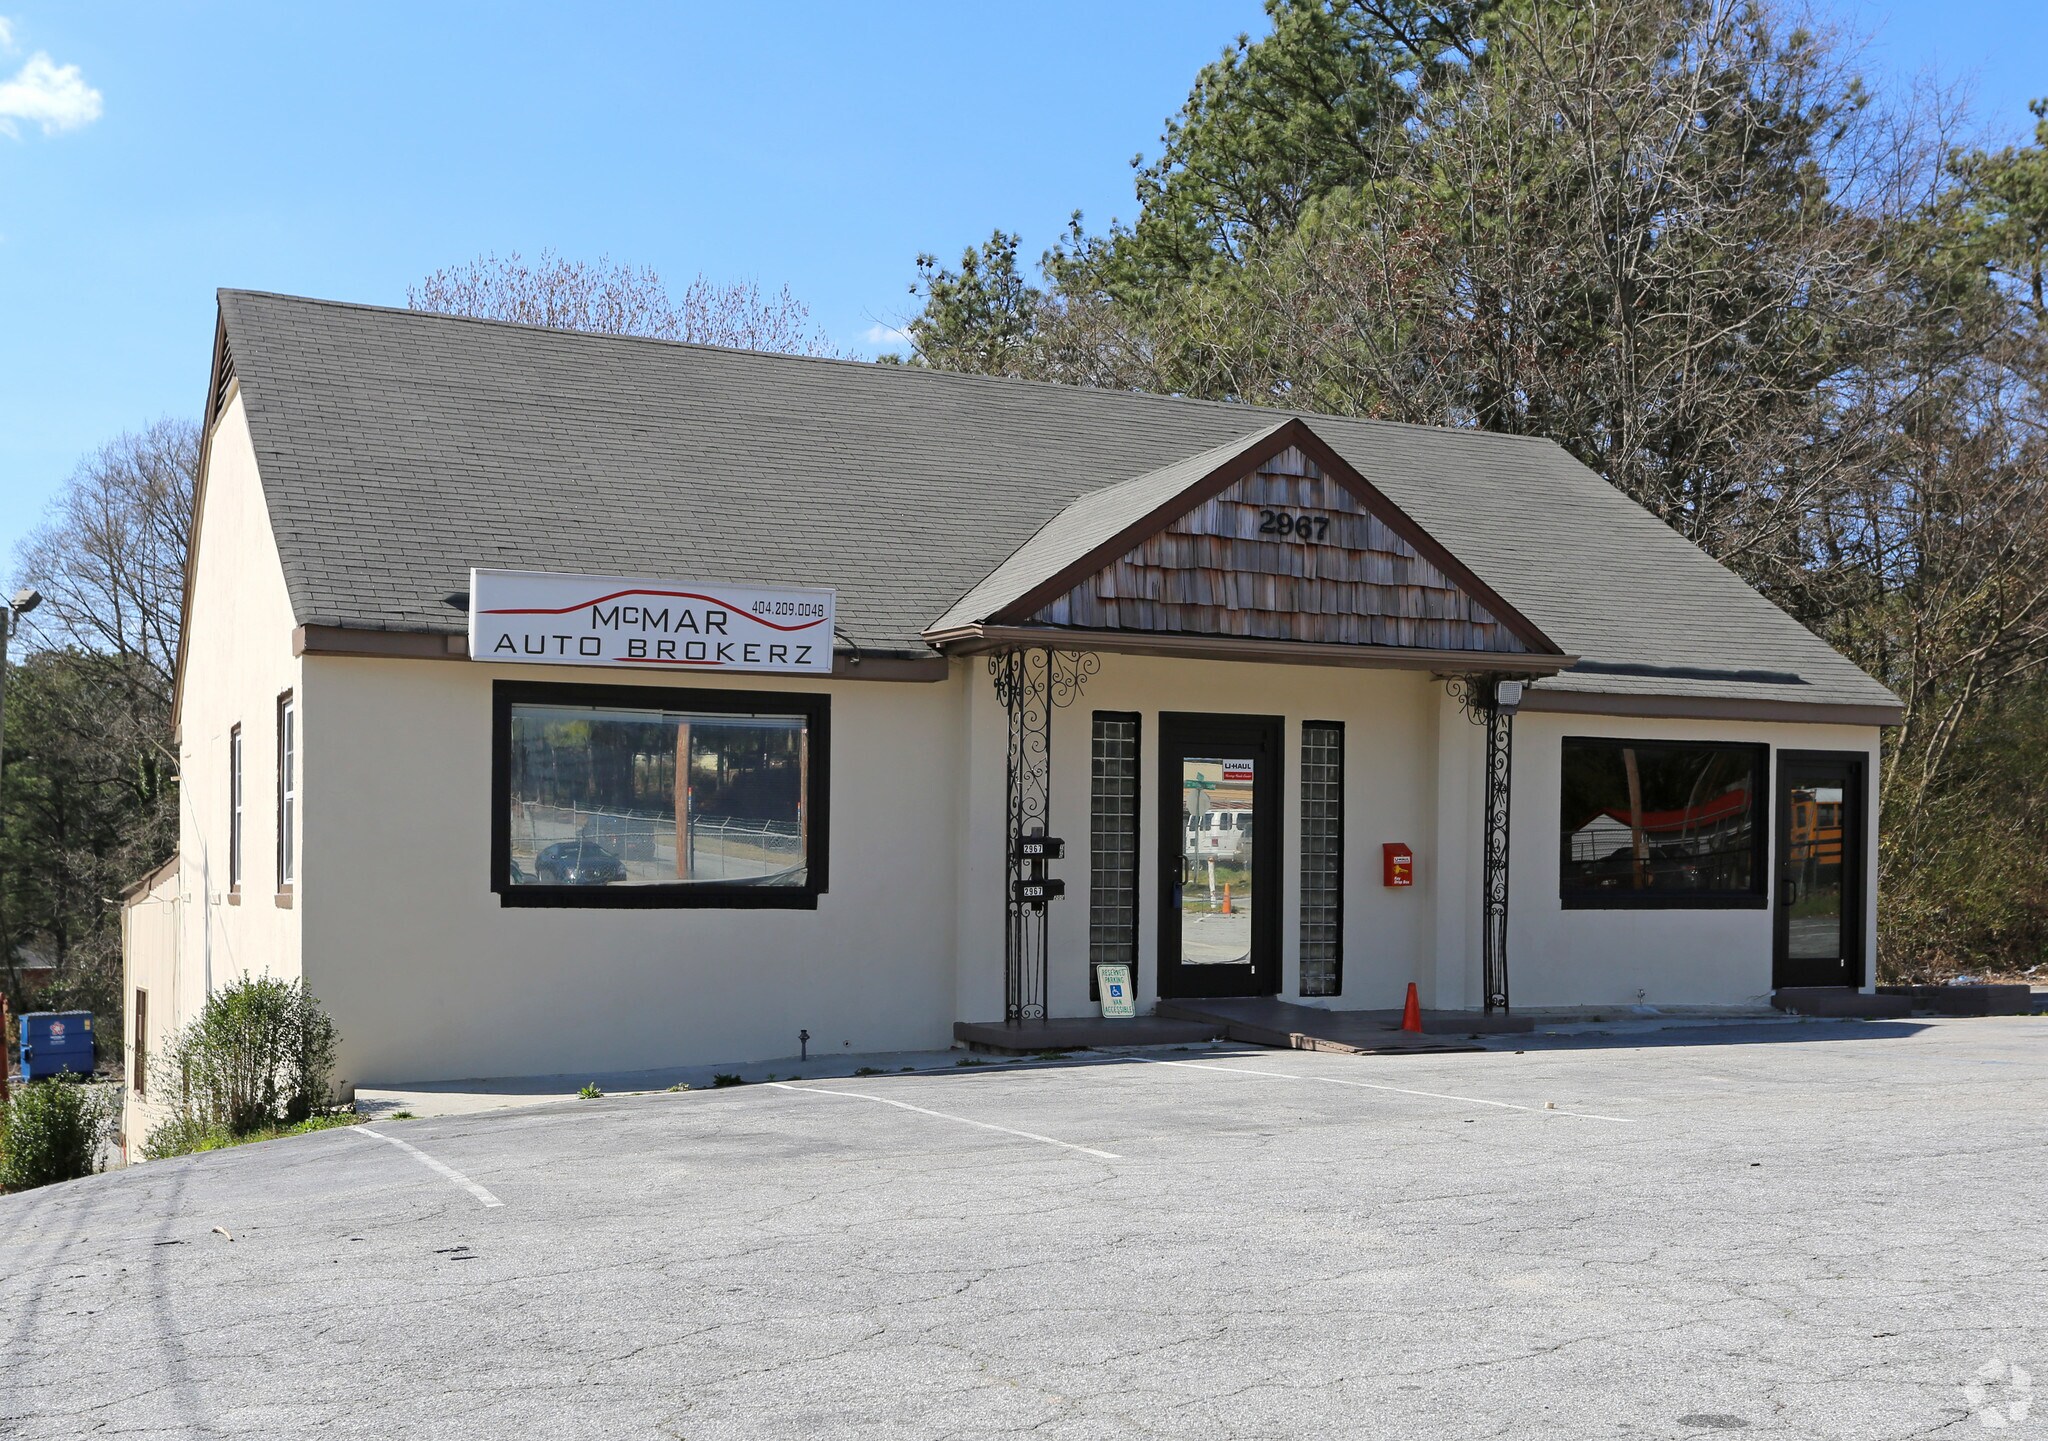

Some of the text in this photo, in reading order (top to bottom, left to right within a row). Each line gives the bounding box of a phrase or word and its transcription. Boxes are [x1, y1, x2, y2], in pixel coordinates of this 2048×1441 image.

[1259, 509, 1330, 540] 2967
[752, 600, 824, 617] 404.209.0048
[493, 633, 812, 665] AUTO BROKERZ
[1024, 845, 1042, 853] 2967
[1024, 887, 1042, 896] 2967
